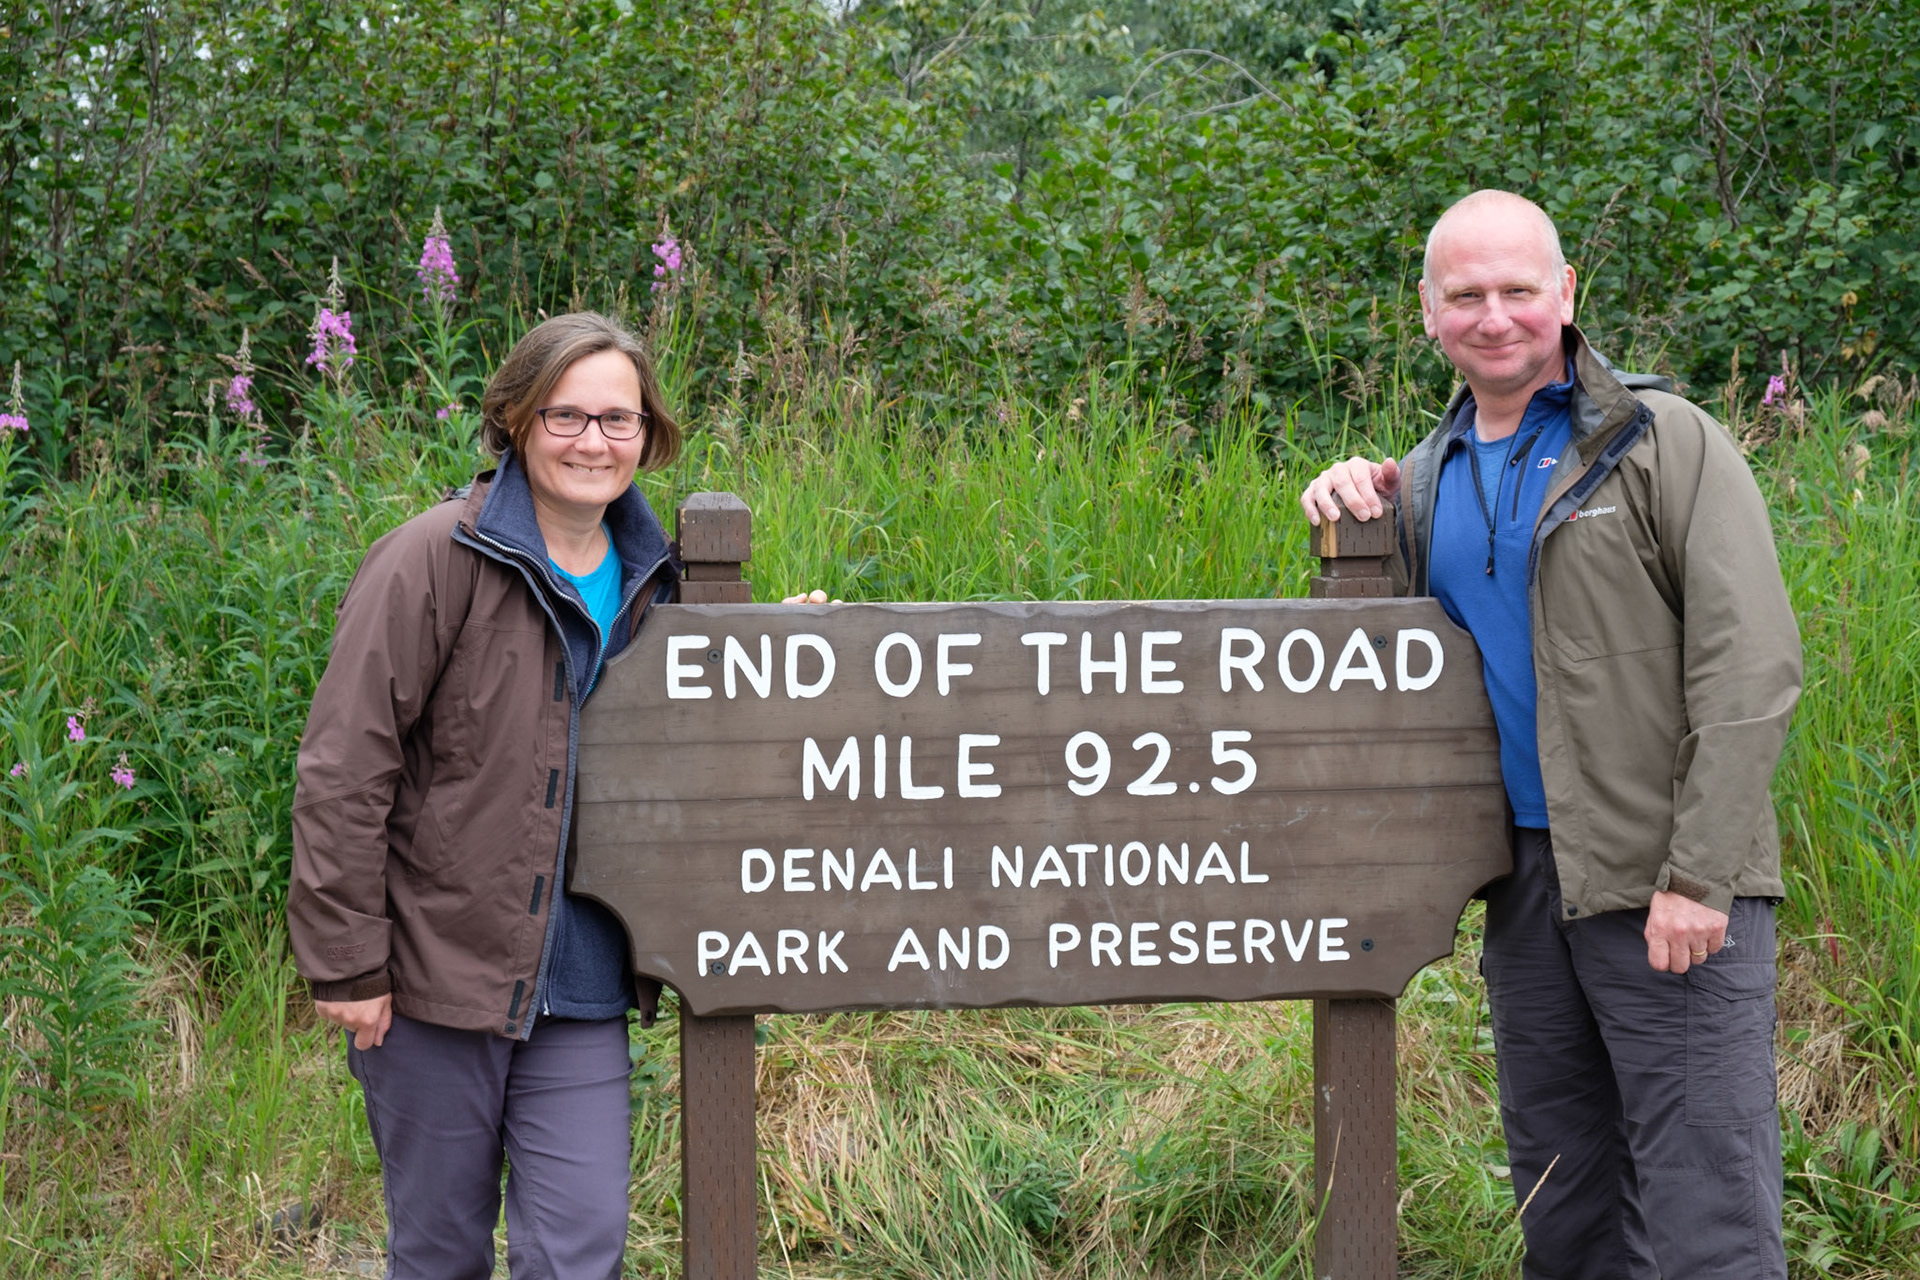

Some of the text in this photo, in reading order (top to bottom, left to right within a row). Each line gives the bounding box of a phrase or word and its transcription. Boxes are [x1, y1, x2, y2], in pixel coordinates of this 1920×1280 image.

[1579, 505, 1616, 518] berghaus
[666, 627, 1444, 700] END OF THE ROAD
[802, 730, 1257, 801] MILE 92.5
[741, 841, 1270, 894] DENALI NATIONAL
[697, 918, 1351, 977] PARK AND PRESERVE
